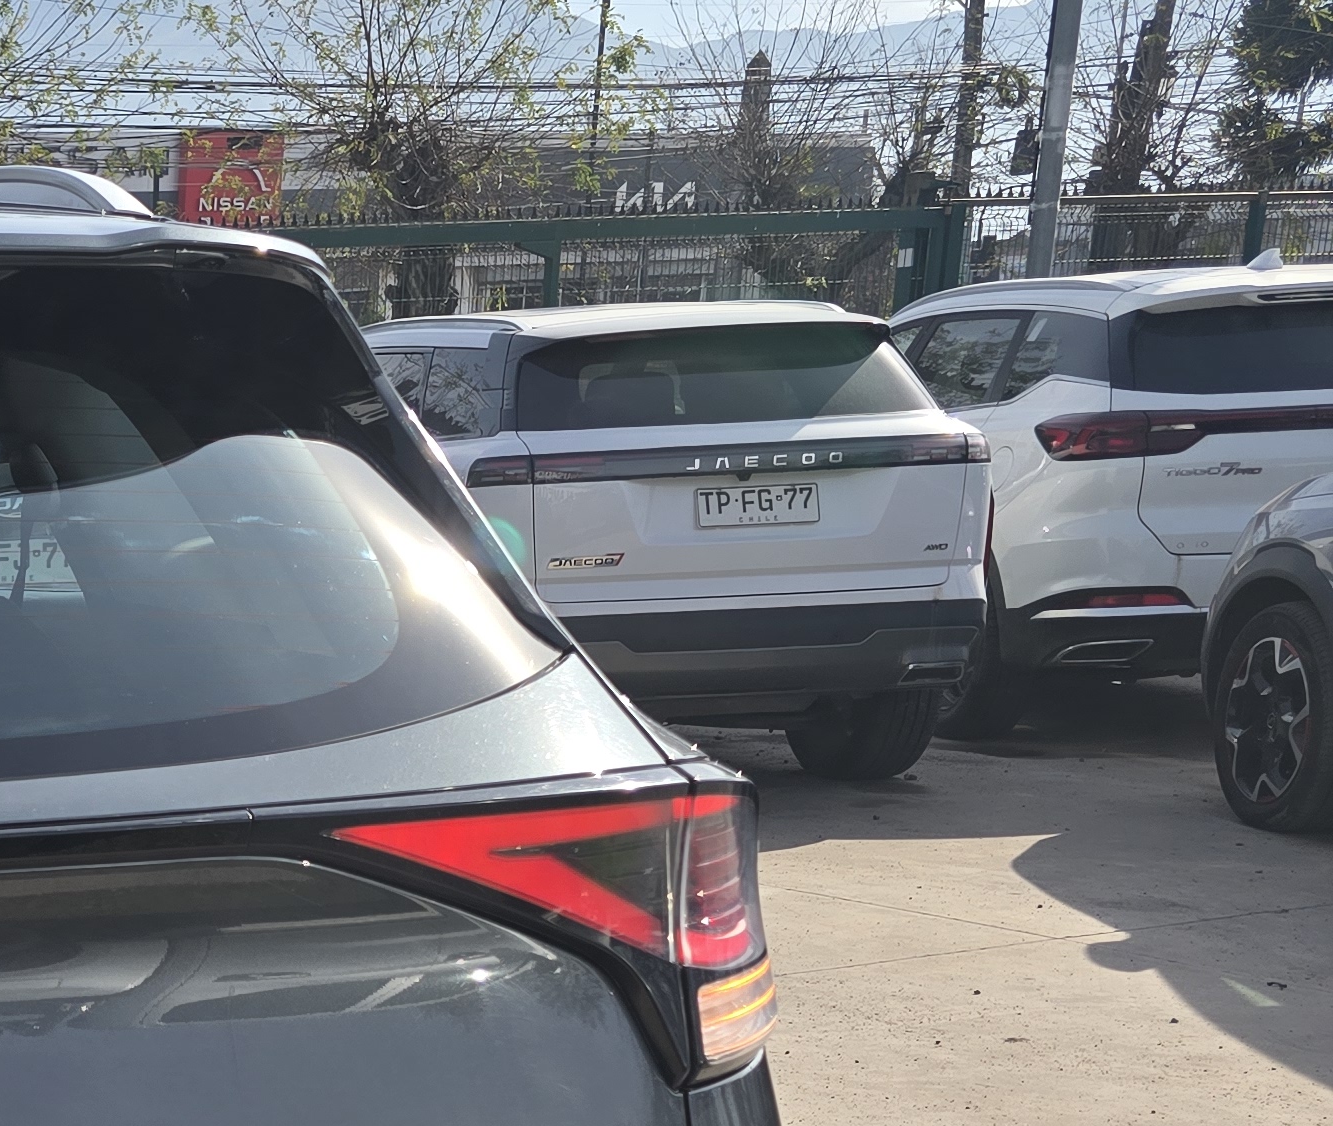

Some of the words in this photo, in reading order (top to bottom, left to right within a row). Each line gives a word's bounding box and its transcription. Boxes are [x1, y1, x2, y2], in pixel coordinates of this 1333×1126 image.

[686, 451, 843, 470] JAECOO
[739, 515, 779, 523] CHILE
[923, 543, 948, 551] AWD
